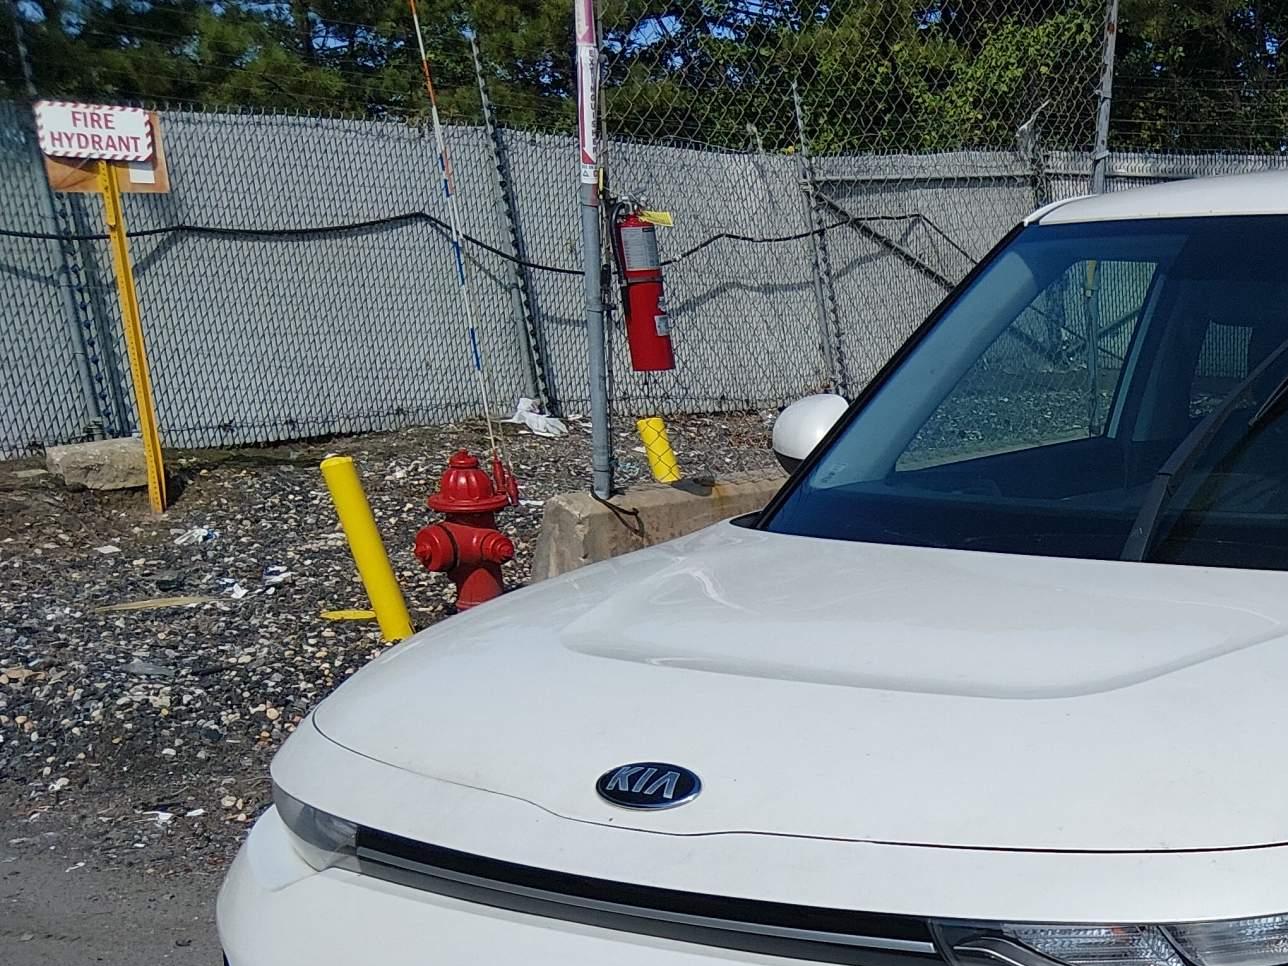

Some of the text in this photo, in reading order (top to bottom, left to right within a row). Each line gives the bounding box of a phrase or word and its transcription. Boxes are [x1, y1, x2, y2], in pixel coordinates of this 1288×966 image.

[71, 111, 116, 129] FIRE
[50, 131, 140, 153] HYDRANT
[606, 766, 681, 799] KIA
